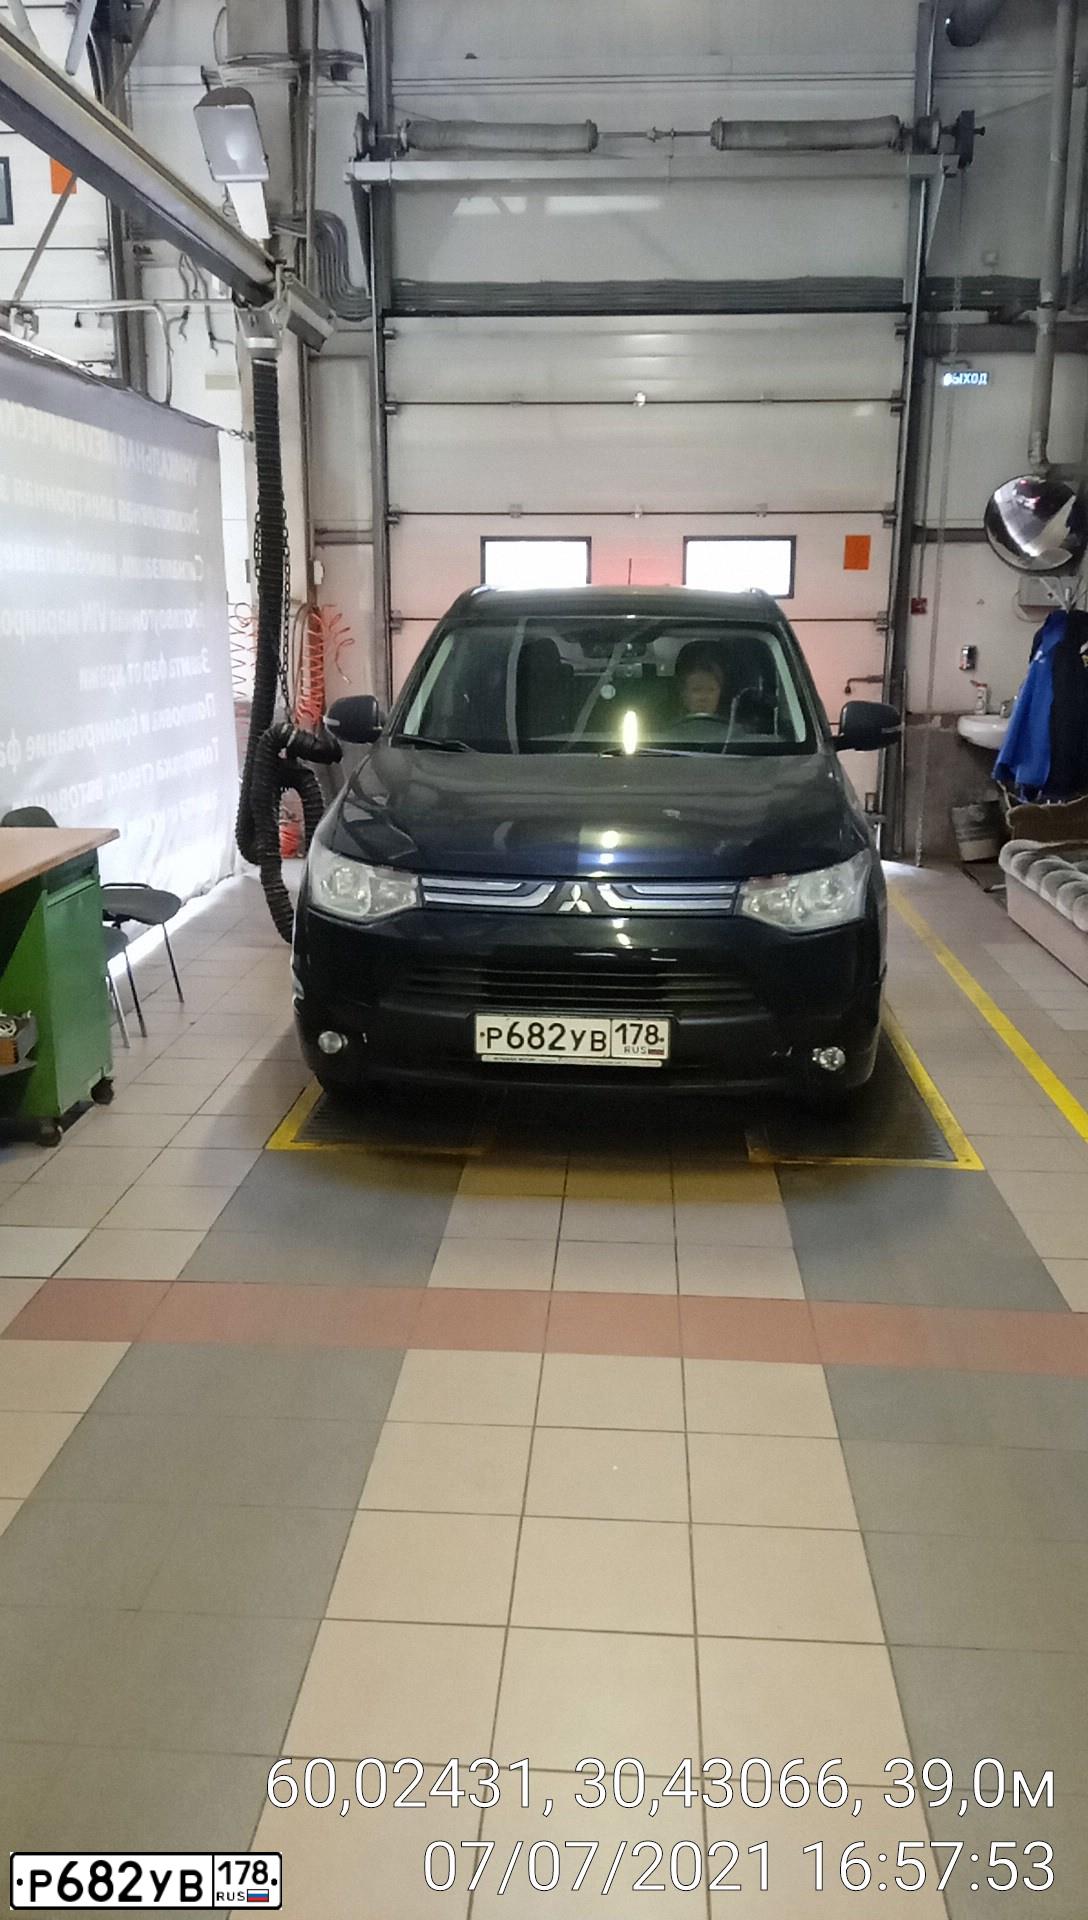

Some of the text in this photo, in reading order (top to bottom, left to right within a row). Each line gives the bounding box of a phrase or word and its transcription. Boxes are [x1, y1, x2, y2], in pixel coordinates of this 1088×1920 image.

[486, 1021, 659, 1052] Р682УВ 178
[624, 1046, 647, 1055] RUS
